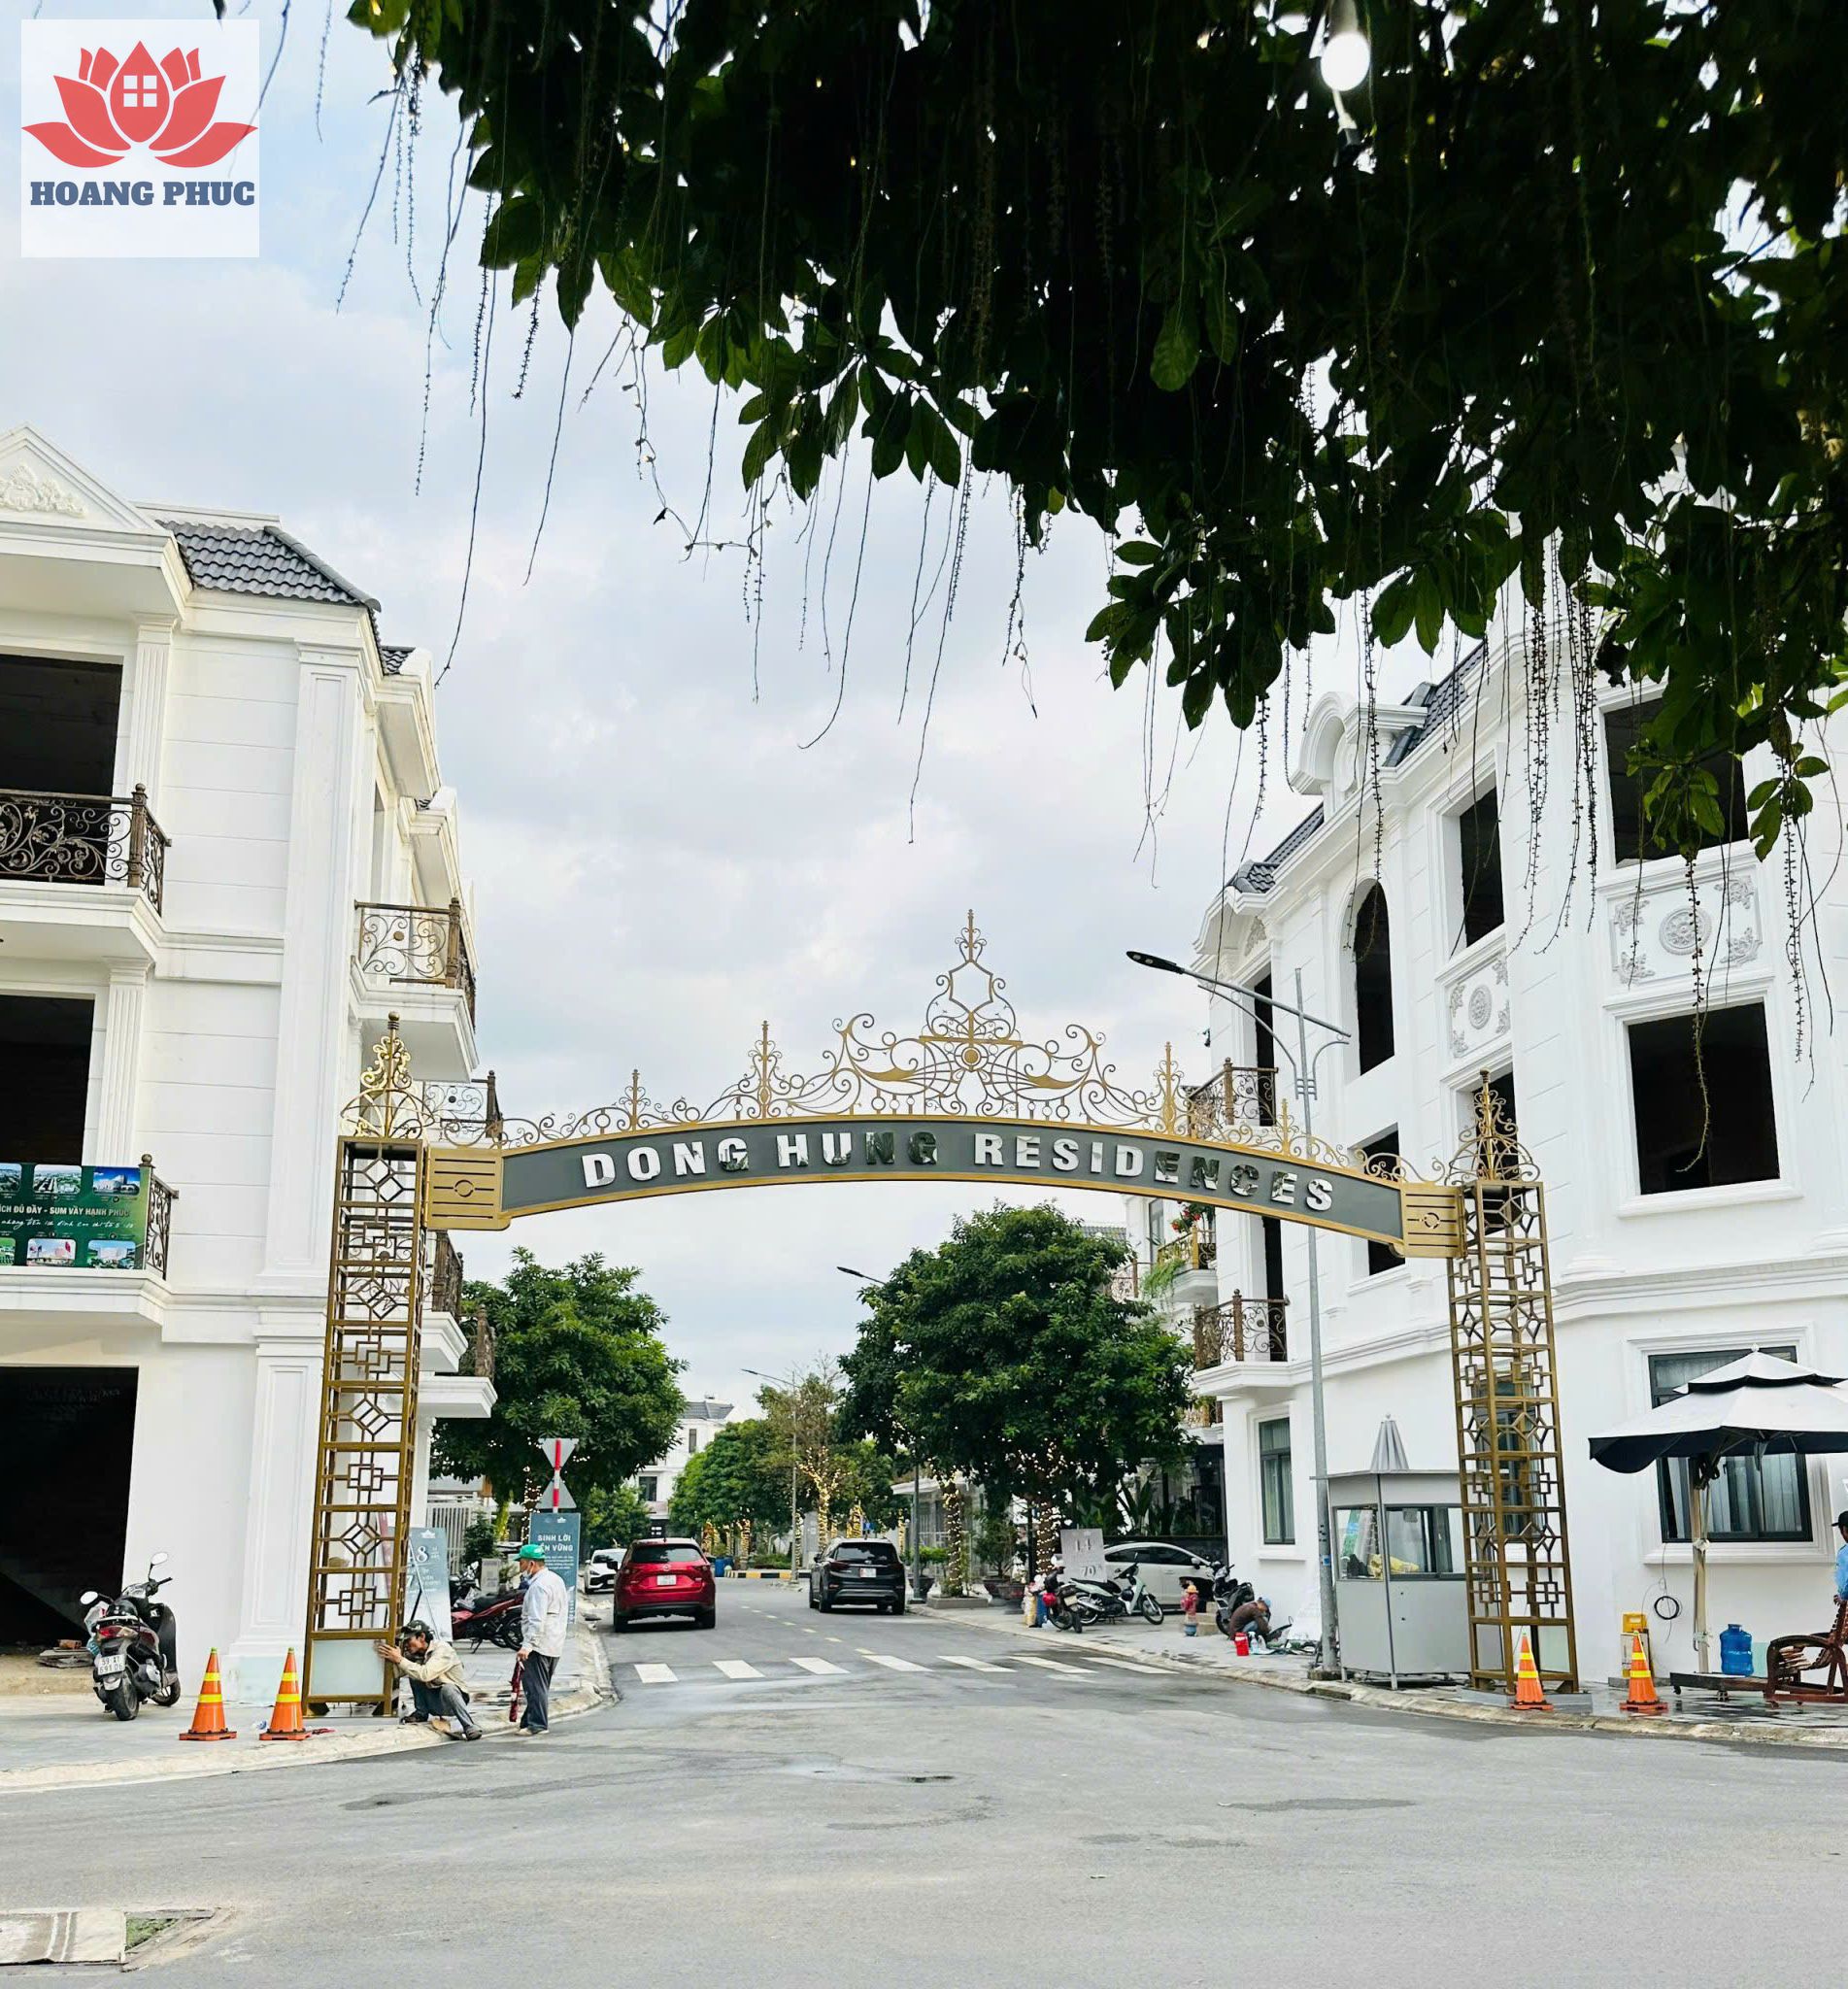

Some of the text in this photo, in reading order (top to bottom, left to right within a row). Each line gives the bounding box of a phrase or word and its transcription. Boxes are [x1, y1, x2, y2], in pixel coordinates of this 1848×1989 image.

[581, 1130, 1333, 1212] DONG HUNG RESIDENCES
[50, 1206, 67, 1215] SUM
